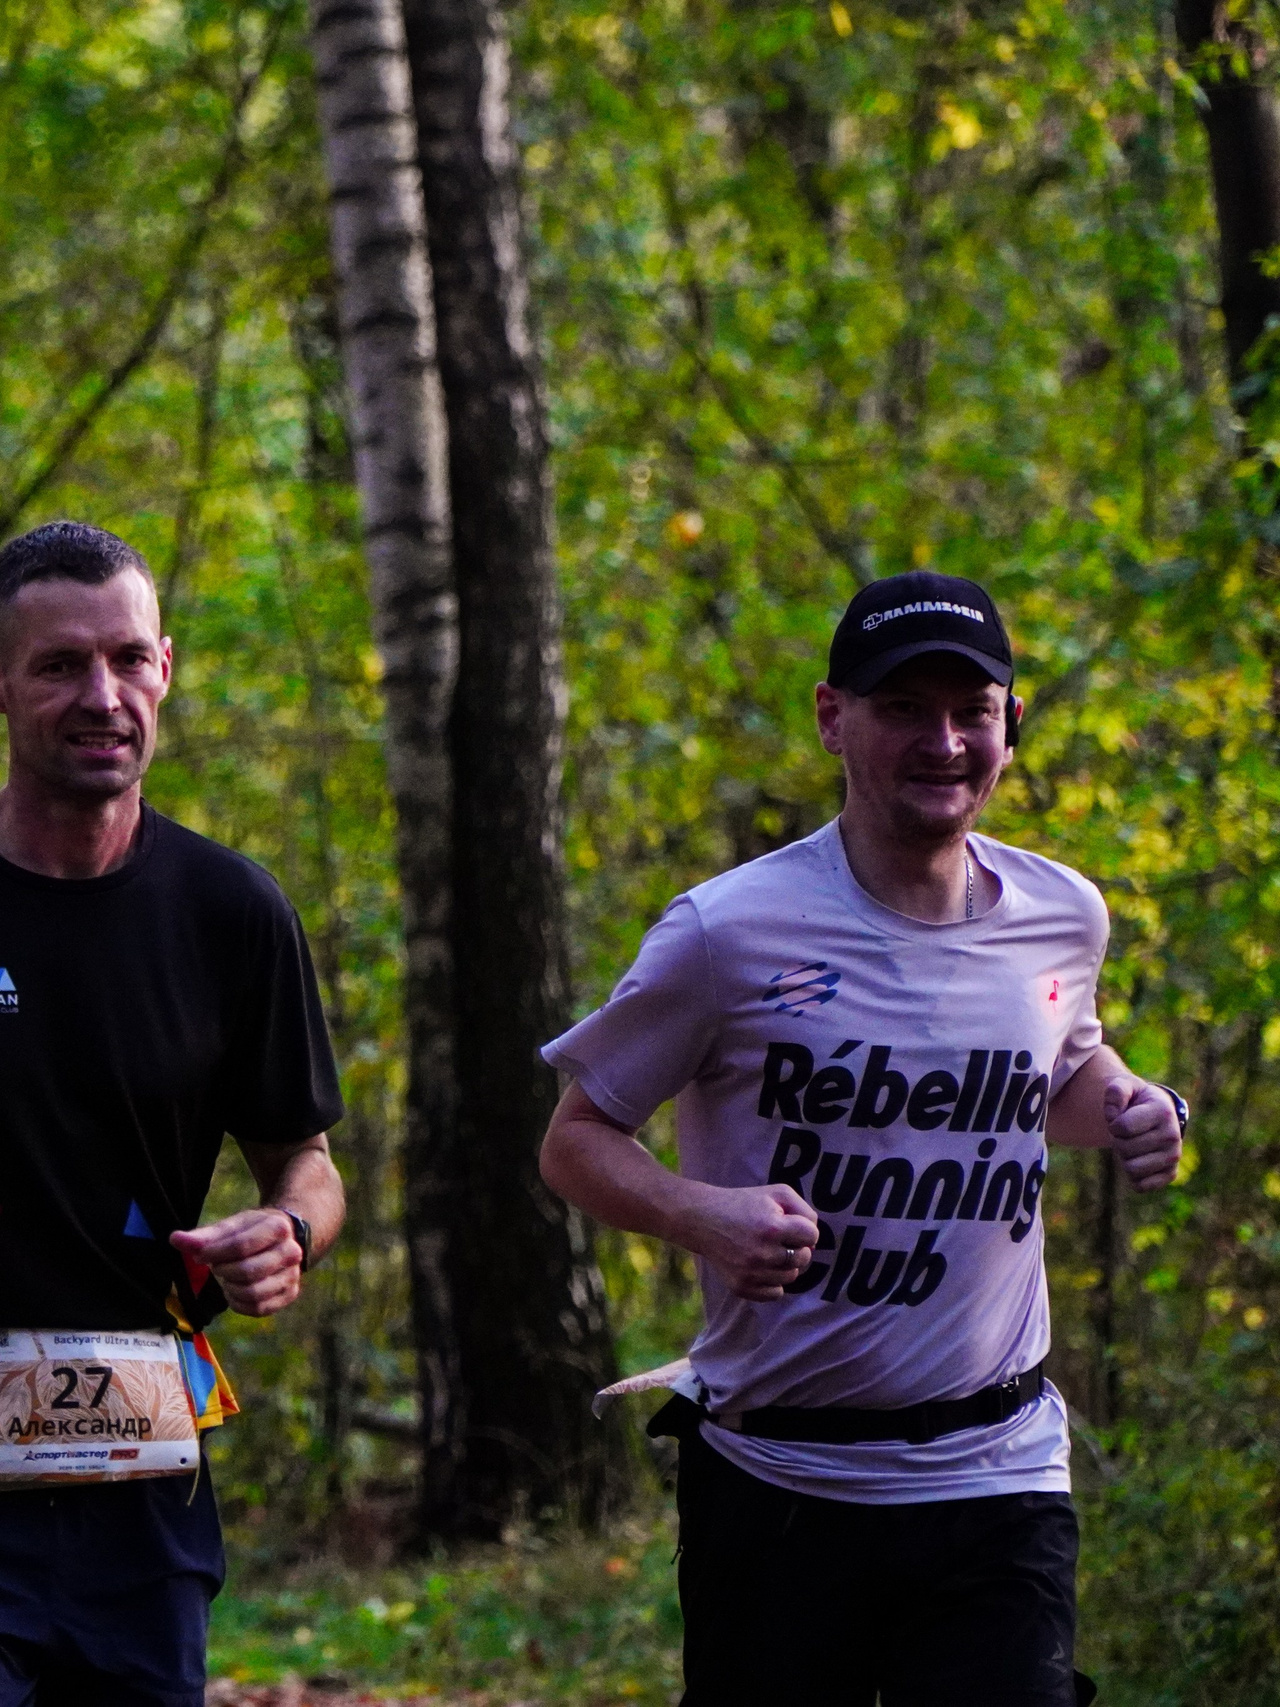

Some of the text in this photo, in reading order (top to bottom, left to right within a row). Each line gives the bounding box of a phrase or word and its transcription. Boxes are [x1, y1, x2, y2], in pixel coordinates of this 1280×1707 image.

[758, 1039, 1049, 1133] Rébellio
[768, 1126, 1046, 1243] Running
[54, 1335, 161, 1347] Backyard Ultra Moscow
[51, 1366, 113, 1409] 27
[8, 1417, 152, 1440] Александр
[35, 1448, 139, 1460] спортмастер PRO
